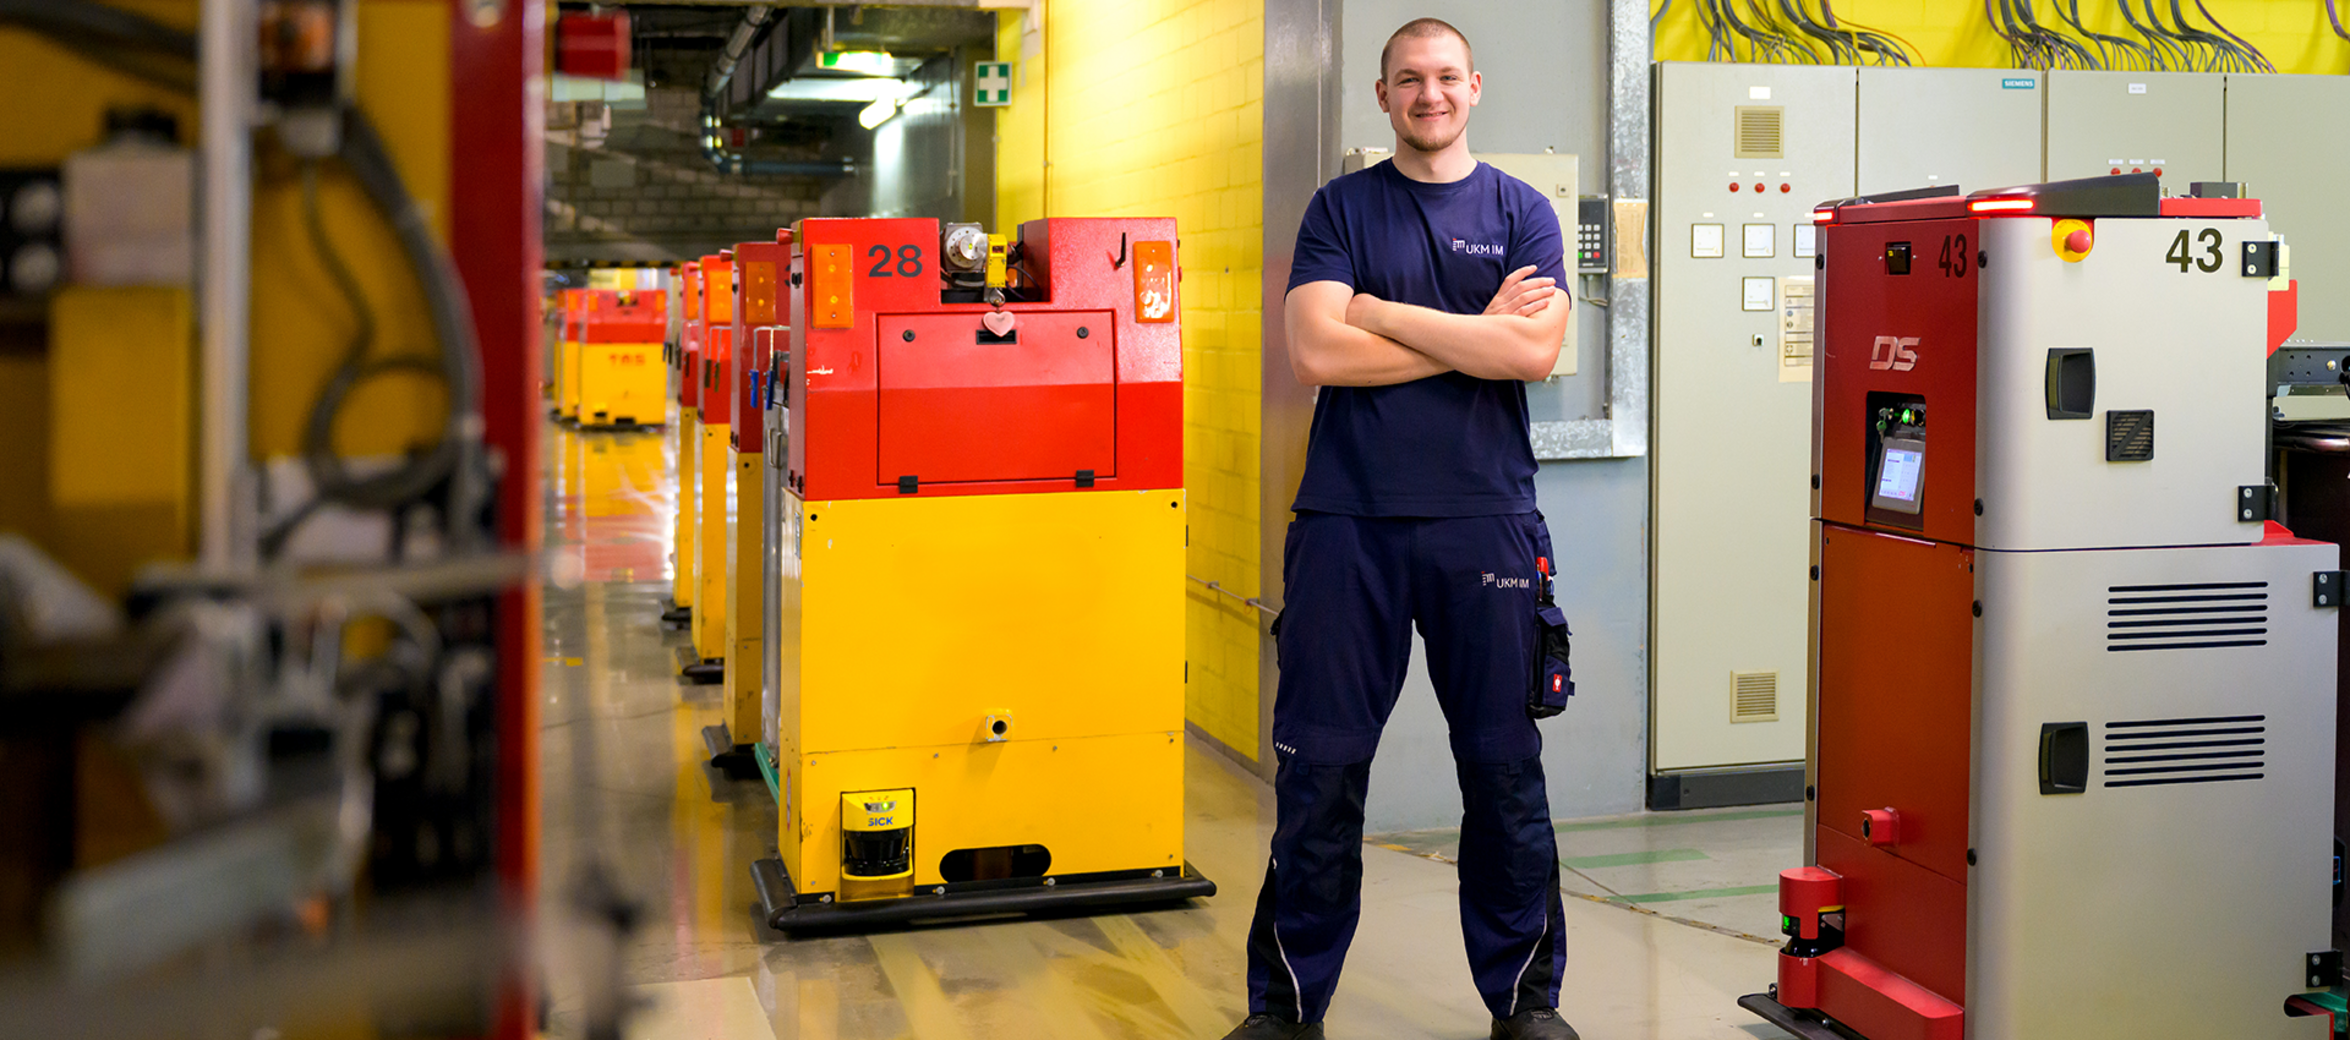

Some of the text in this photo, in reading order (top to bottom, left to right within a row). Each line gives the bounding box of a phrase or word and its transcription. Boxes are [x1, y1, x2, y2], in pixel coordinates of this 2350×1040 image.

[868, 244, 923, 278] 28
[1466, 244, 1490, 255] UKM
[1492, 244, 1504, 255] IM
[1938, 233, 1967, 278] 43
[2165, 227, 2223, 273] 43
[1869, 335, 1921, 372] DS
[1496, 578, 1518, 589] UKM
[868, 816, 893, 826] SICK
